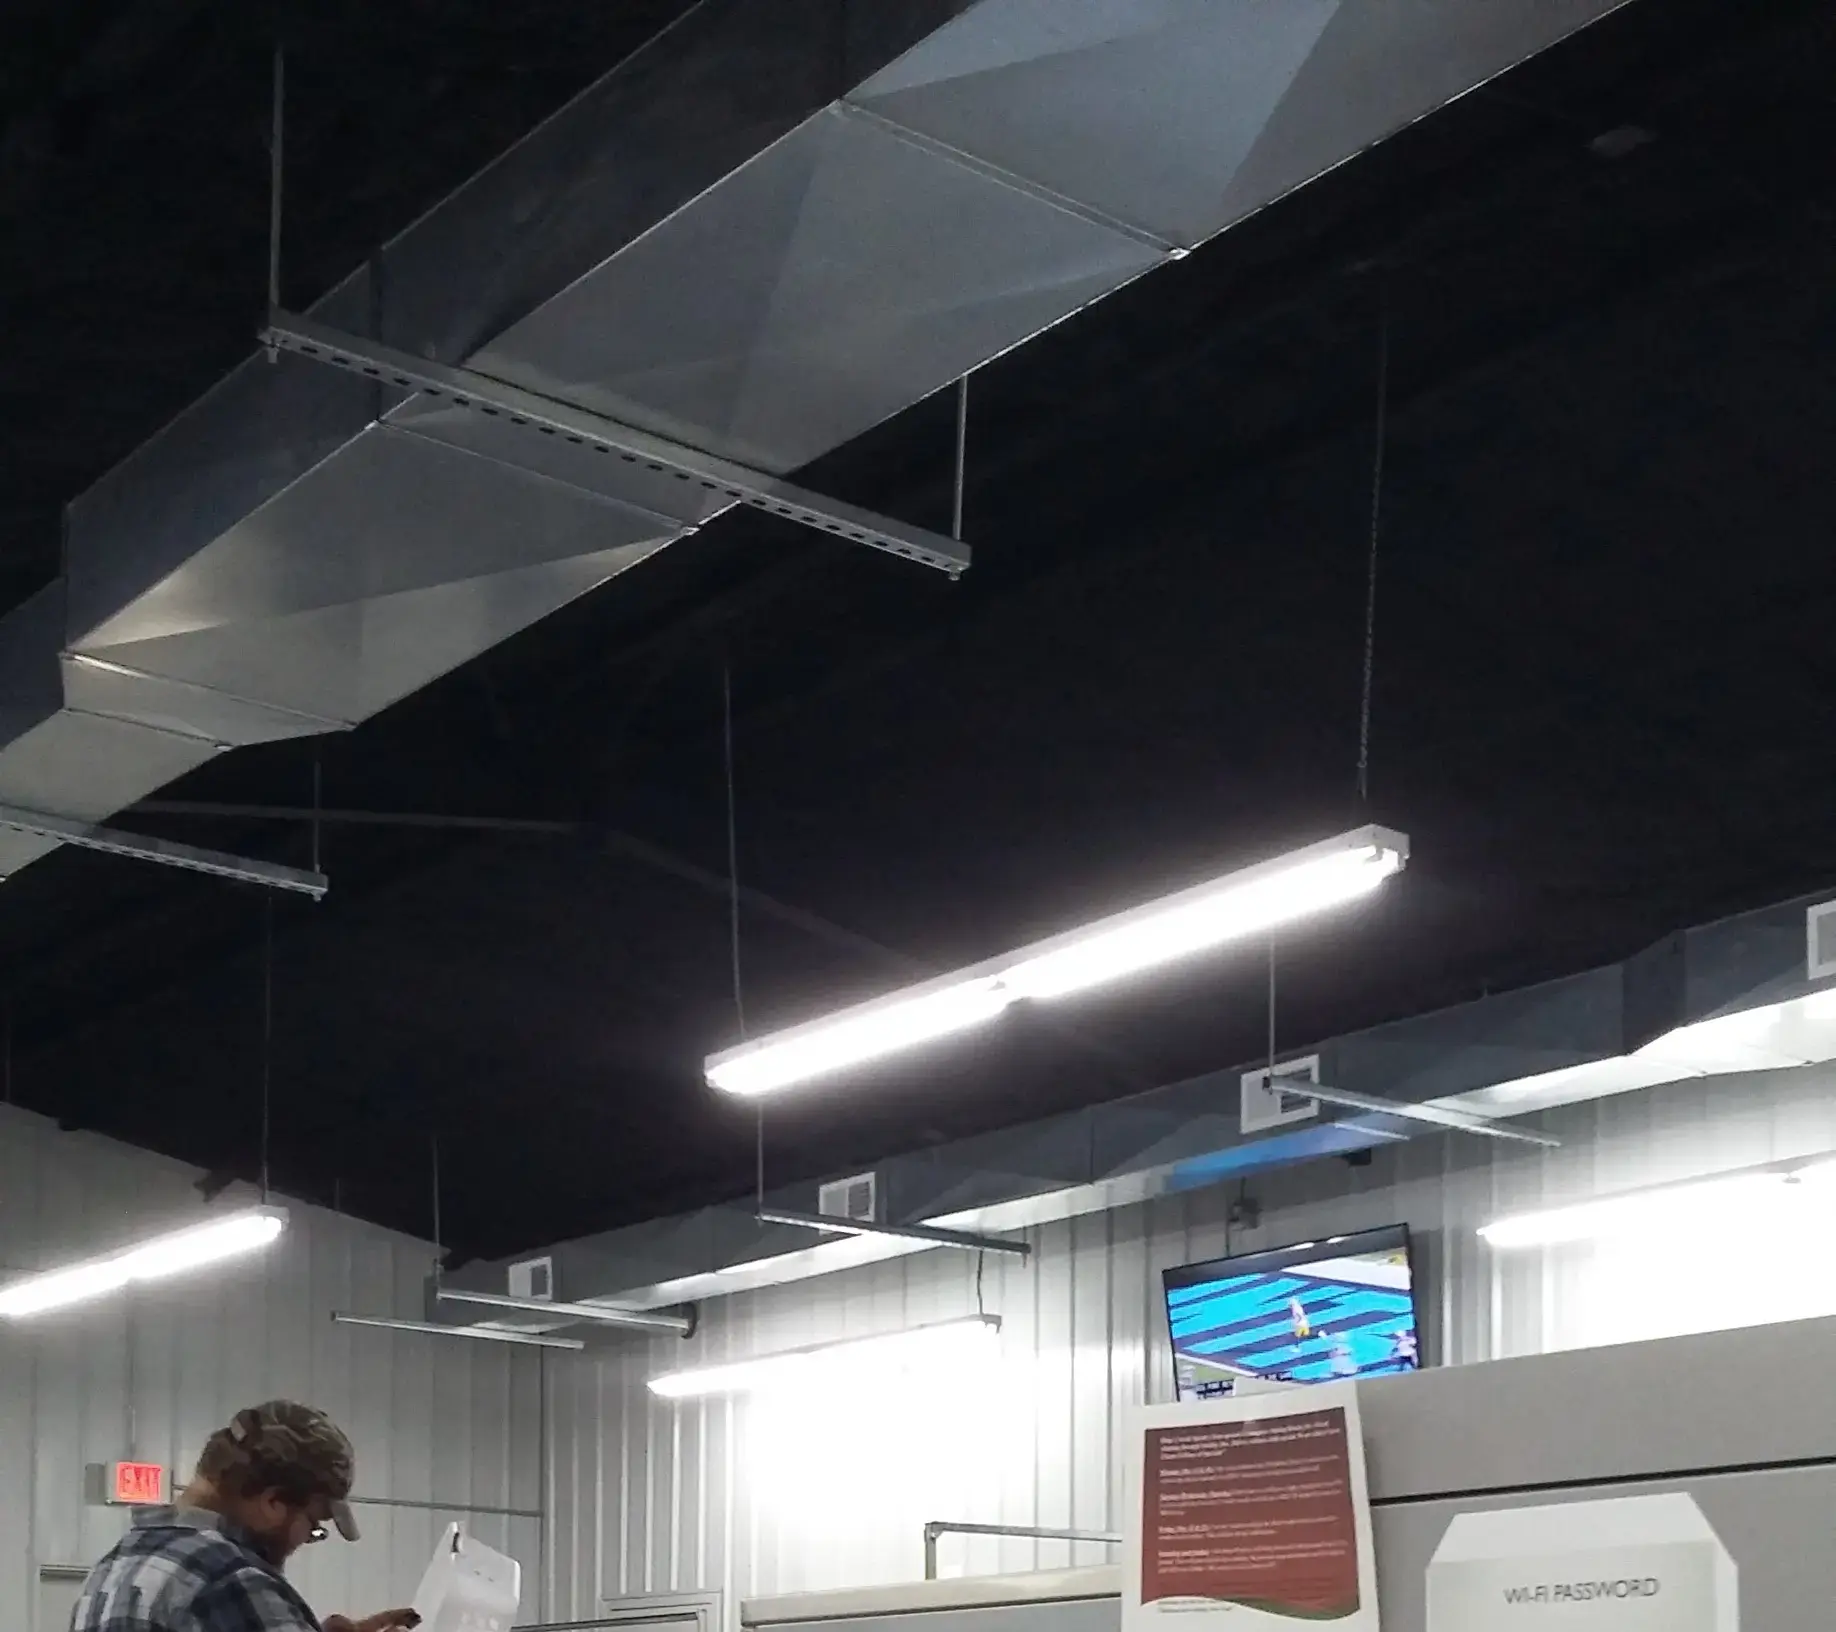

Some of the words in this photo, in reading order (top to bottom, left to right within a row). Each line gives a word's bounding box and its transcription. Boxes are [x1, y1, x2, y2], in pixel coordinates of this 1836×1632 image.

[120, 1465, 160, 1497] EXIT
[1503, 1585, 1548, 1604] WI-FI
[1554, 1577, 1661, 1603] PASSWORD
